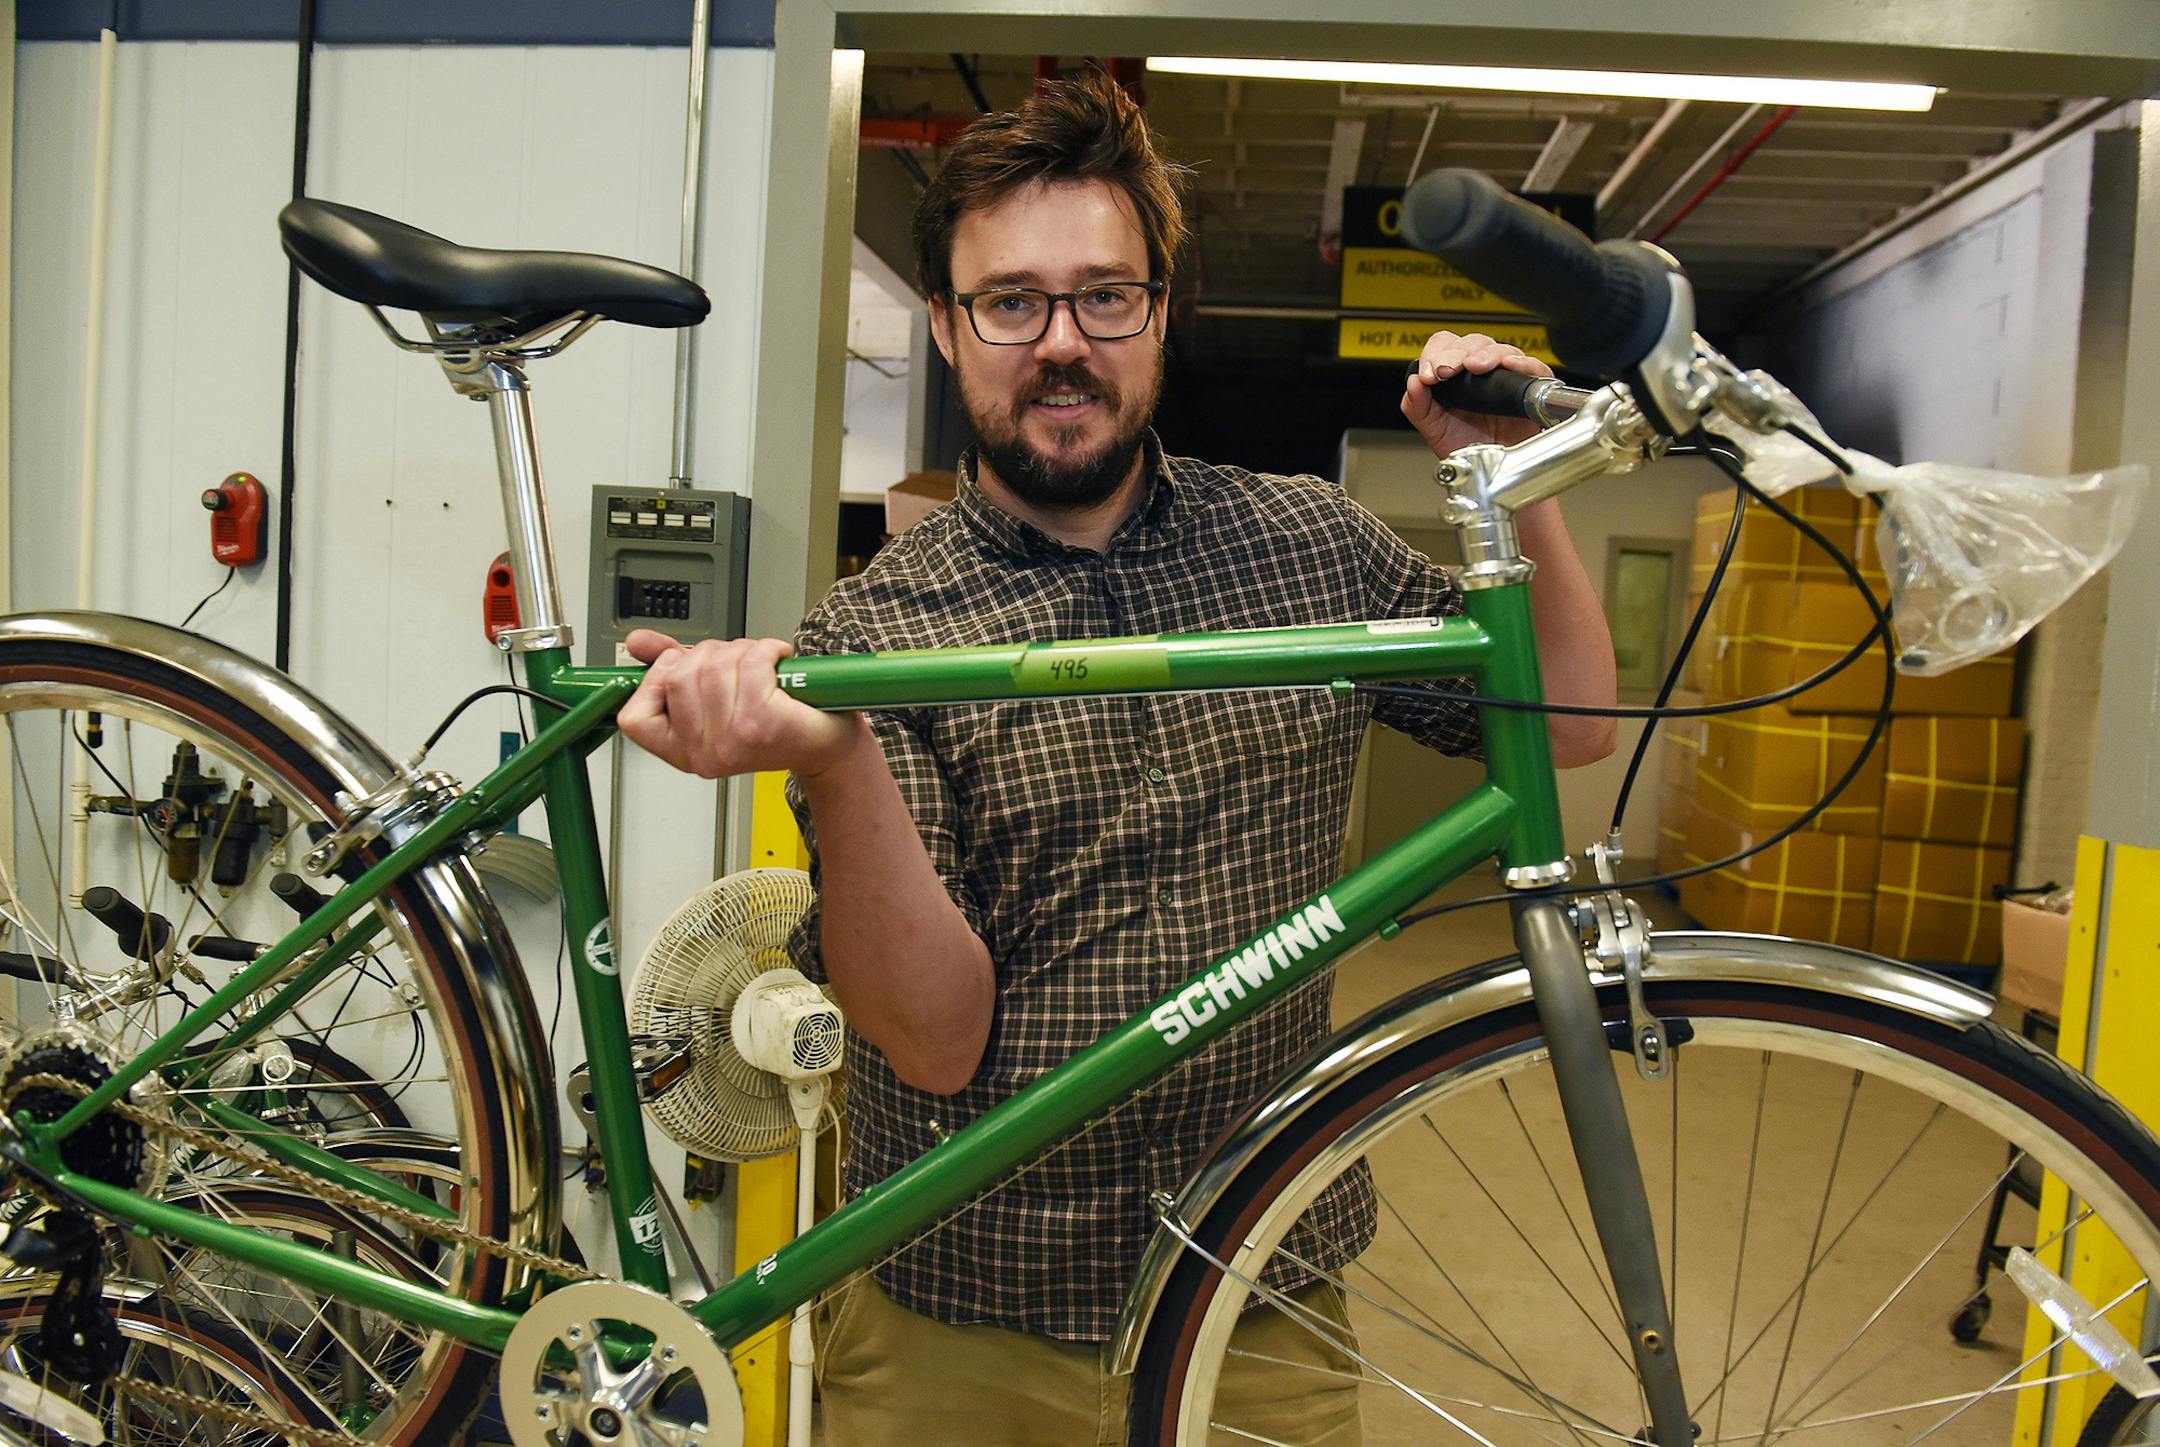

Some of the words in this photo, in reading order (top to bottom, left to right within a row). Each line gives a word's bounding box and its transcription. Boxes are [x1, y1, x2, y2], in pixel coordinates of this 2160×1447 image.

[1441, 284, 1484, 301] ONLY
[1359, 331, 1393, 347] HOT
[1050, 657, 1088, 680] 495
[1149, 894, 1346, 1046] SCHWINN
